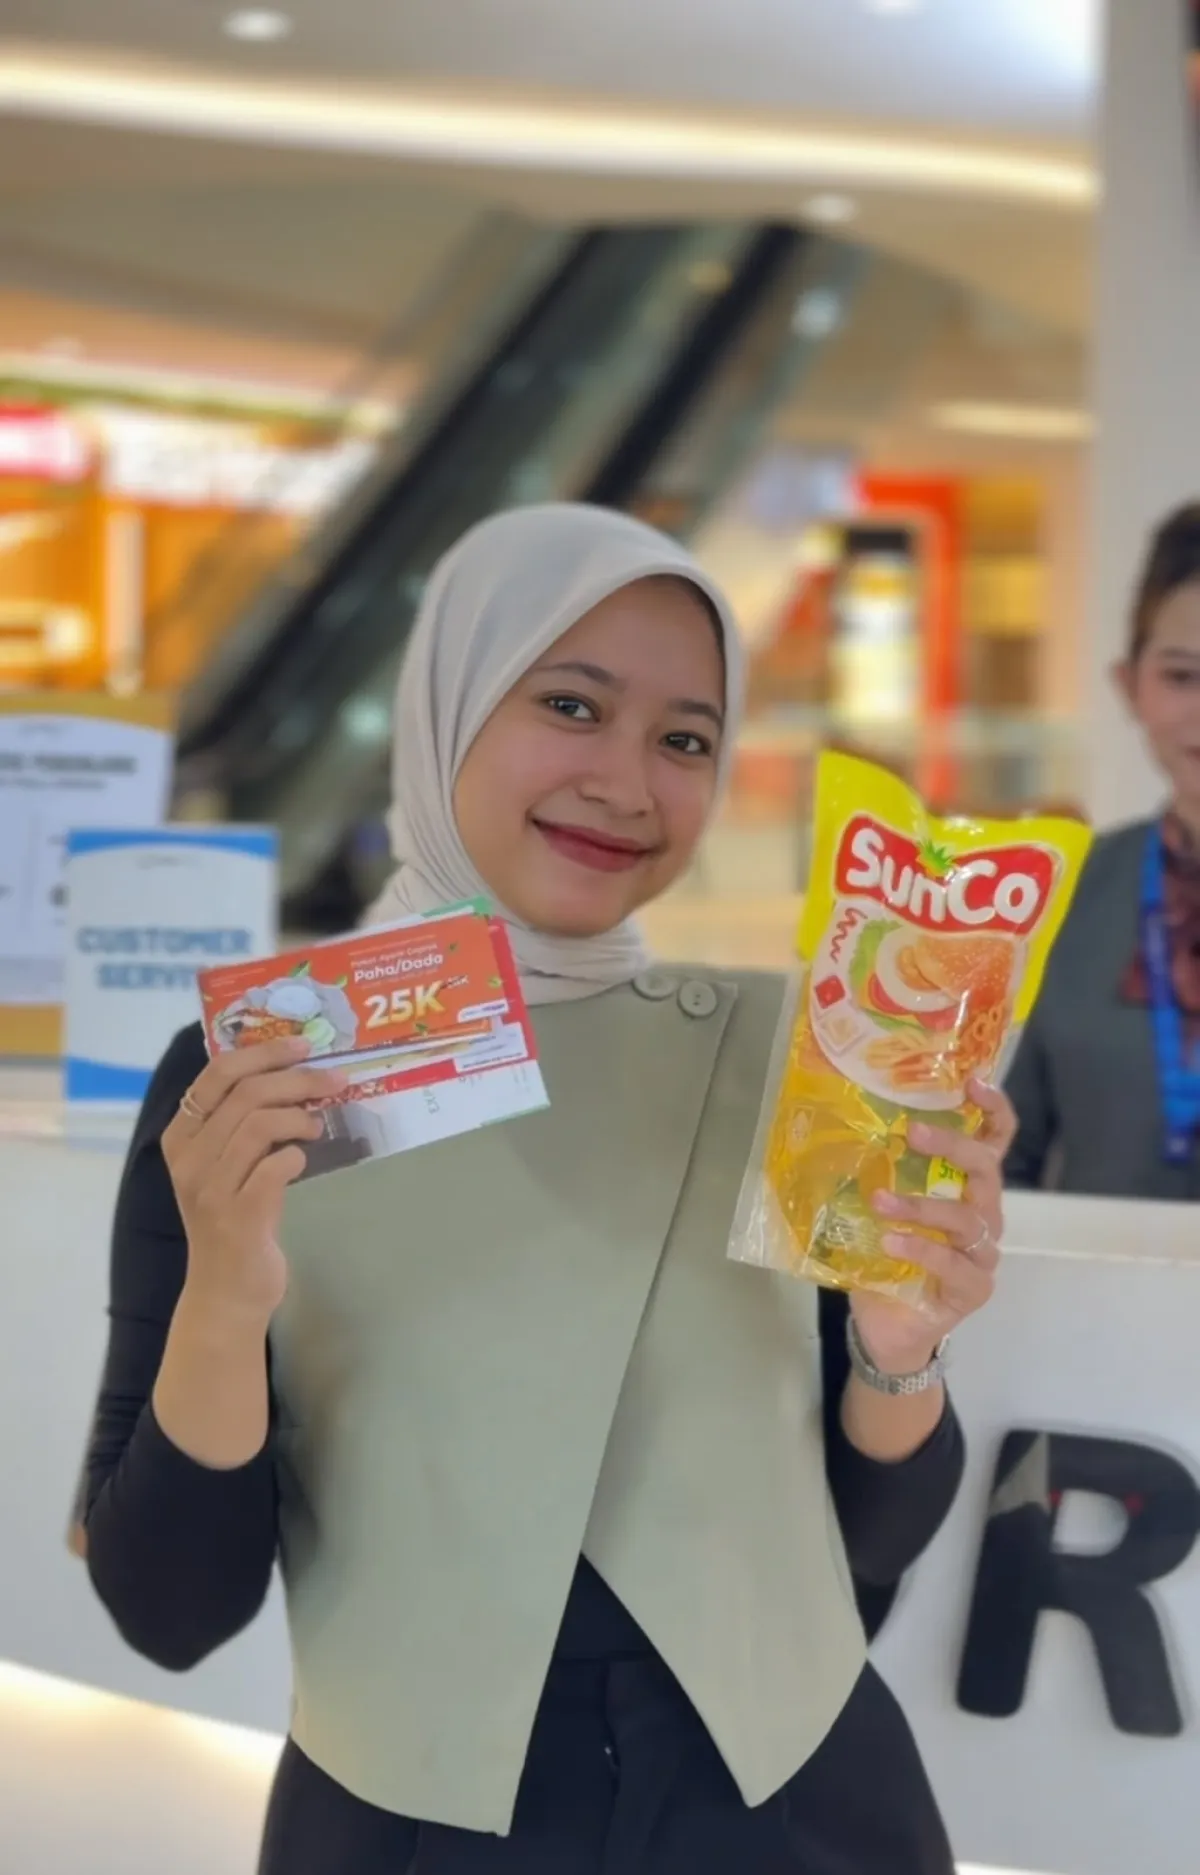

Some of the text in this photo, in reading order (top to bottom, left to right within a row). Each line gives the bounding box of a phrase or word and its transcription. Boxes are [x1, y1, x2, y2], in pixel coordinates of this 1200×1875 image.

[846, 827, 1040, 924] SunCo
[77, 927, 252, 956] CUSTOMER
[354, 954, 444, 983] Paha/Dada
[364, 980, 445, 1030] 25K
[956, 1429, 1200, 1738] R
